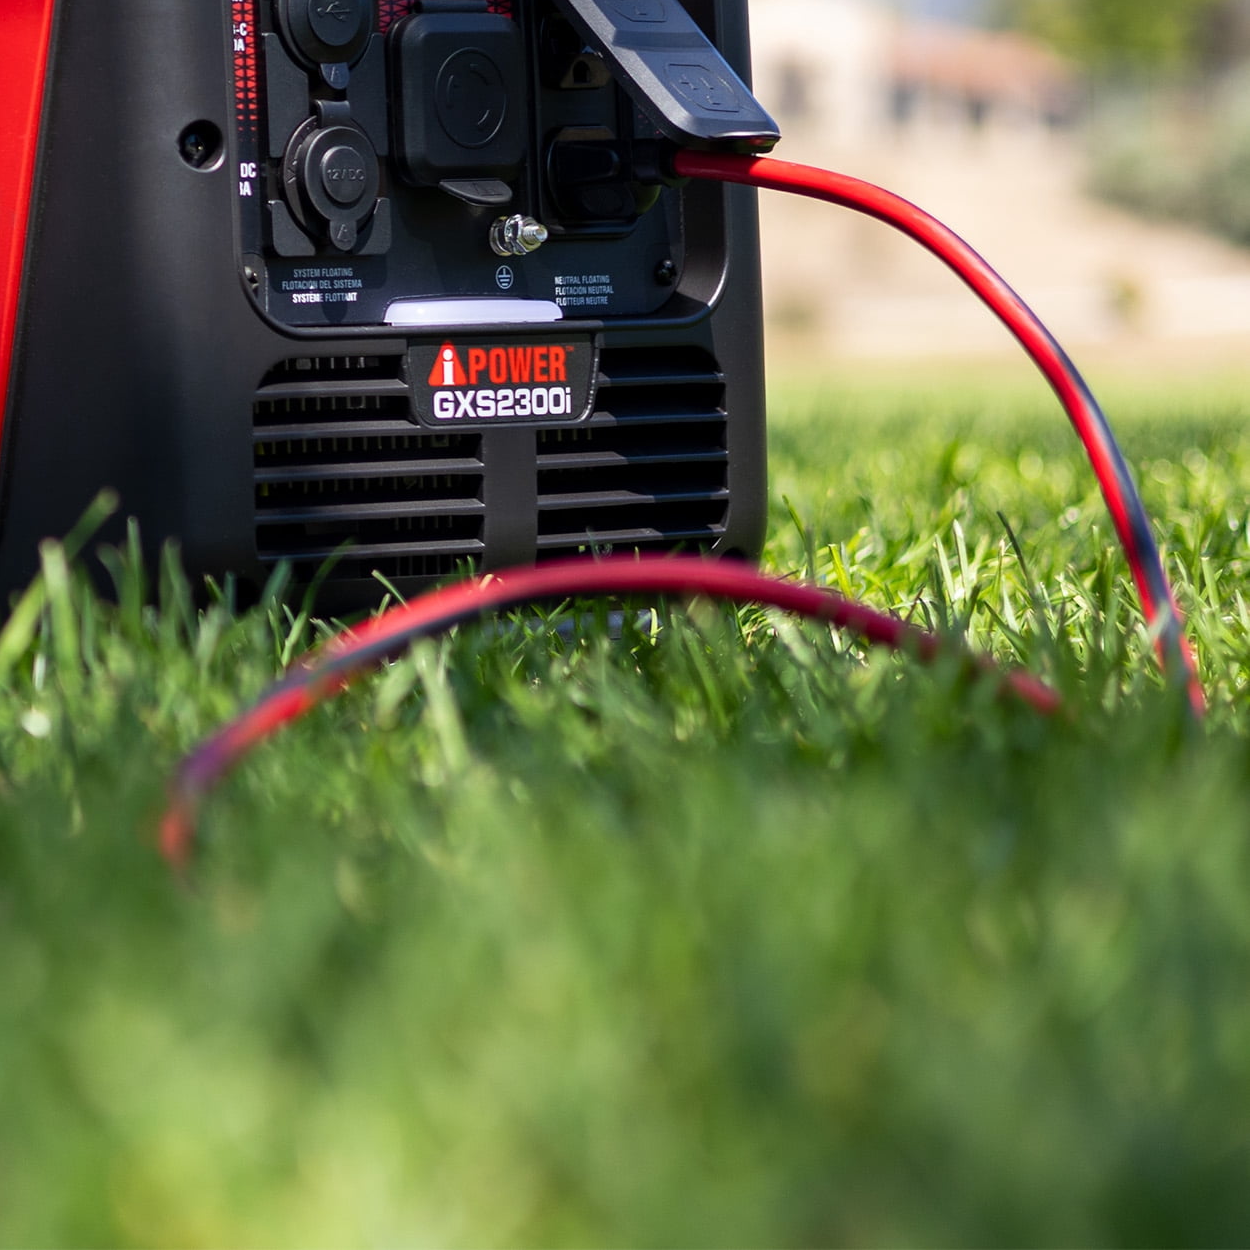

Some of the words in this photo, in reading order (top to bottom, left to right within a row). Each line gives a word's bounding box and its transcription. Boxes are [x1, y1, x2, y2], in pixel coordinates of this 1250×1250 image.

[240, 163, 257, 178] DC
[293, 269, 320, 278] SYSTEM
[322, 268, 353, 277] FLOATING
[319, 280, 332, 289] DEL
[333, 279, 362, 289] SISTEMA
[555, 276, 581, 285] NEUTRAL
[582, 275, 610, 284] FLOATING
[588, 286, 614, 294] NEUTRAL
[586, 296, 608, 305] NEUTRE
[467, 346, 567, 385] POWER
[433, 387, 571, 419] GXS2300i
